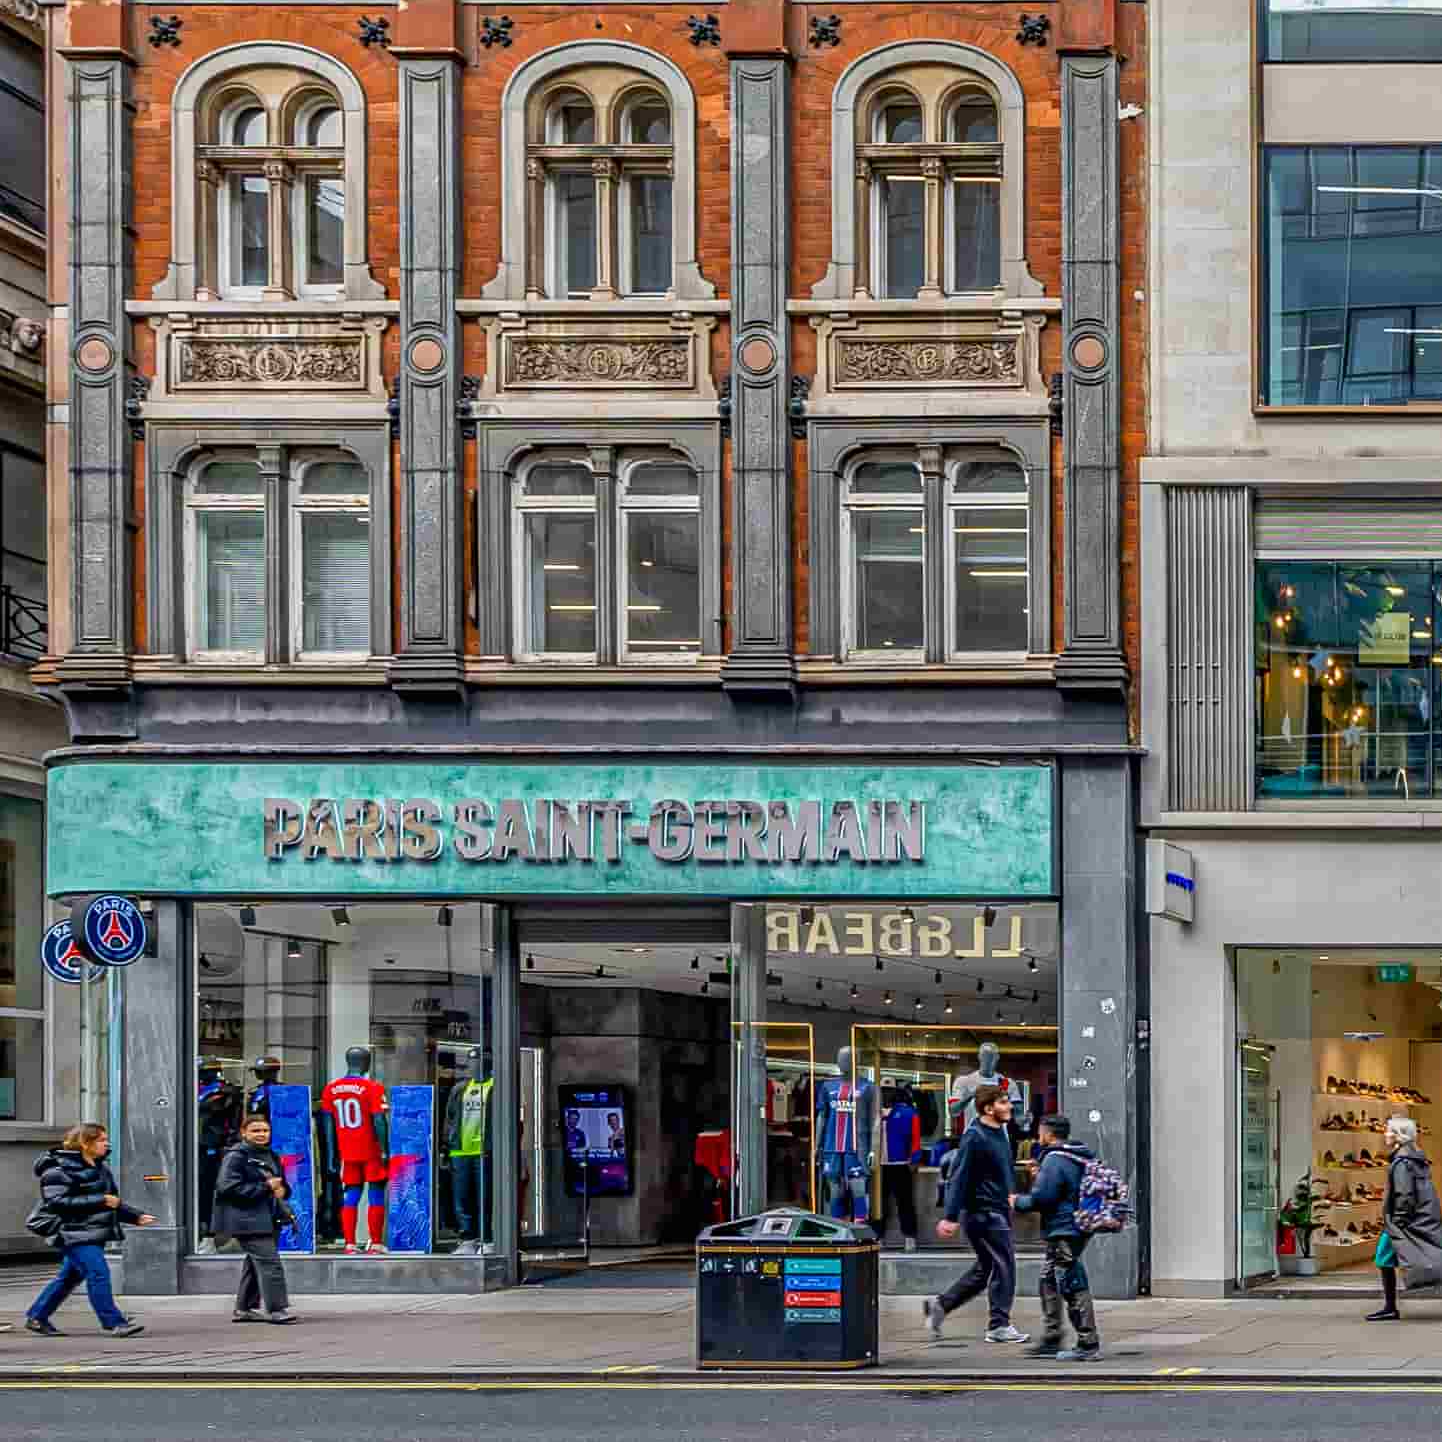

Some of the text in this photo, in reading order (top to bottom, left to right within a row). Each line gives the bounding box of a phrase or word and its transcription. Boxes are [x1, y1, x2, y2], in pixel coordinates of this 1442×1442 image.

[263, 798, 929, 864] PARIS SAINT-GERMAIN
[94, 899, 134, 918] PARIS
[333, 1098, 362, 1129] 10
